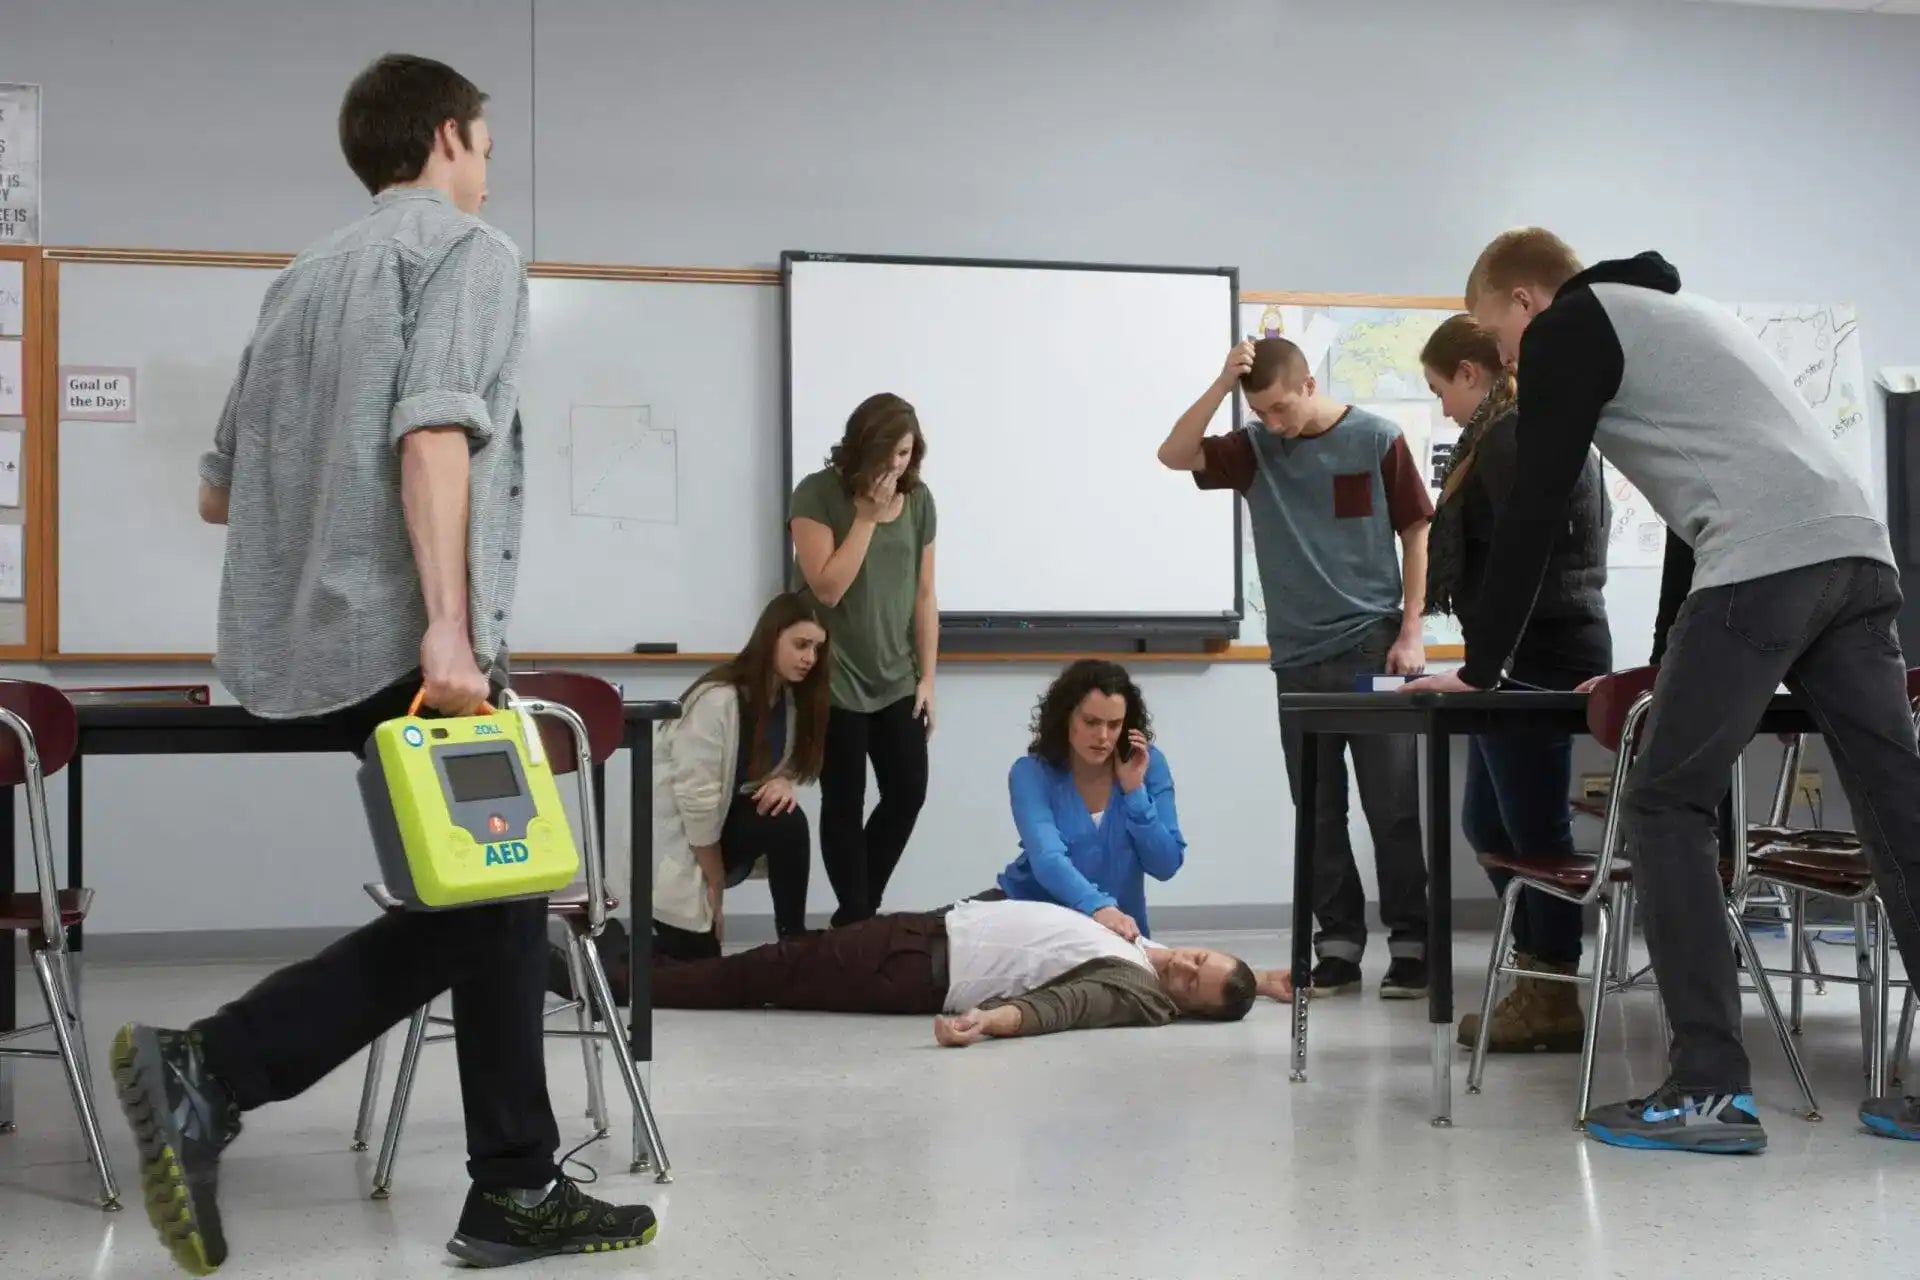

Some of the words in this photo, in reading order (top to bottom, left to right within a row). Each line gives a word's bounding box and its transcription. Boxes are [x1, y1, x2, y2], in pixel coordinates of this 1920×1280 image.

[8, 174, 20, 188] IS
[14, 208, 27, 223] IS
[70, 378, 100, 390] Goal
[104, 378, 119, 390] of
[70, 395, 93, 407] the
[96, 395, 126, 411] Day:
[474, 724, 504, 735] ZOLL
[486, 842, 529, 866] AED
